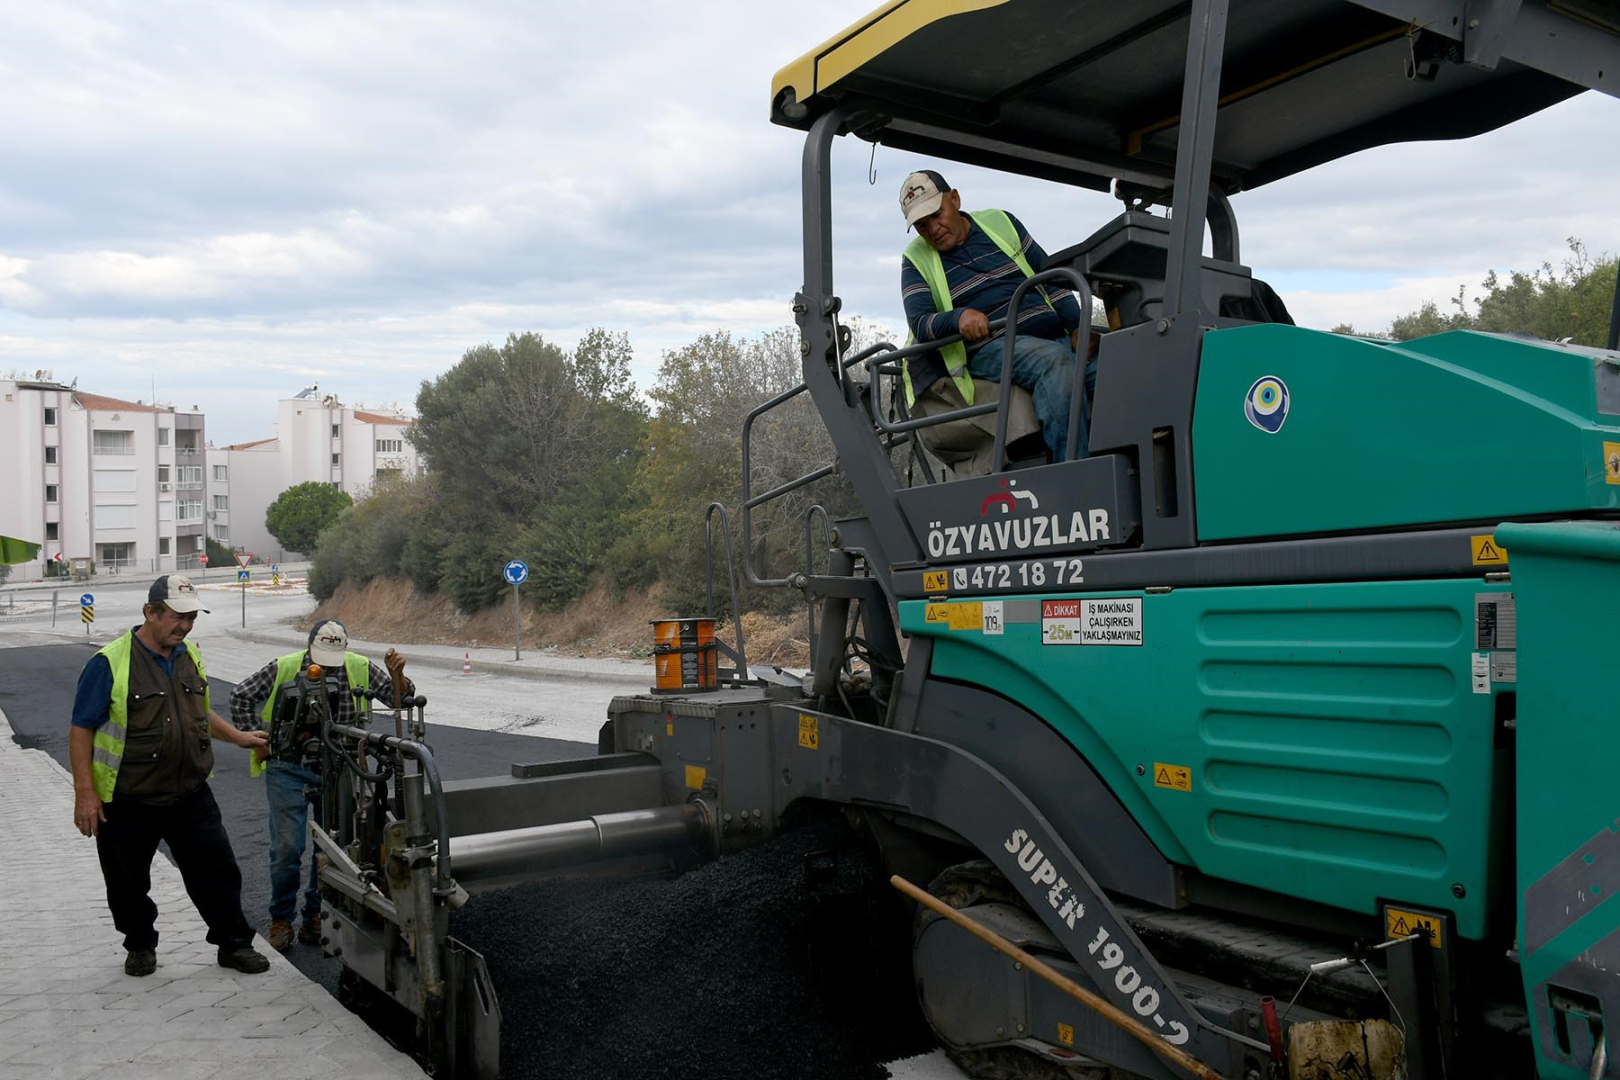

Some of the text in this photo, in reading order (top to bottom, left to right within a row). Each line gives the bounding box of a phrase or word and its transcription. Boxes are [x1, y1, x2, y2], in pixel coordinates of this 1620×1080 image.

[928, 508, 1110, 558] ÖZYAVUZLAR
[971, 559, 1084, 588] 472 18 72
[1053, 603, 1078, 616] DİKKAT
[1088, 602, 1134, 615] İŞ MAKİNASI
[984, 615, 998, 631] 109
[1089, 617, 1134, 629] ÇALIŞIRKEN
[1082, 630, 1141, 642] YAKLAŞMAYINIZ
[1004, 829, 1190, 1045] SUPER 1900-2
